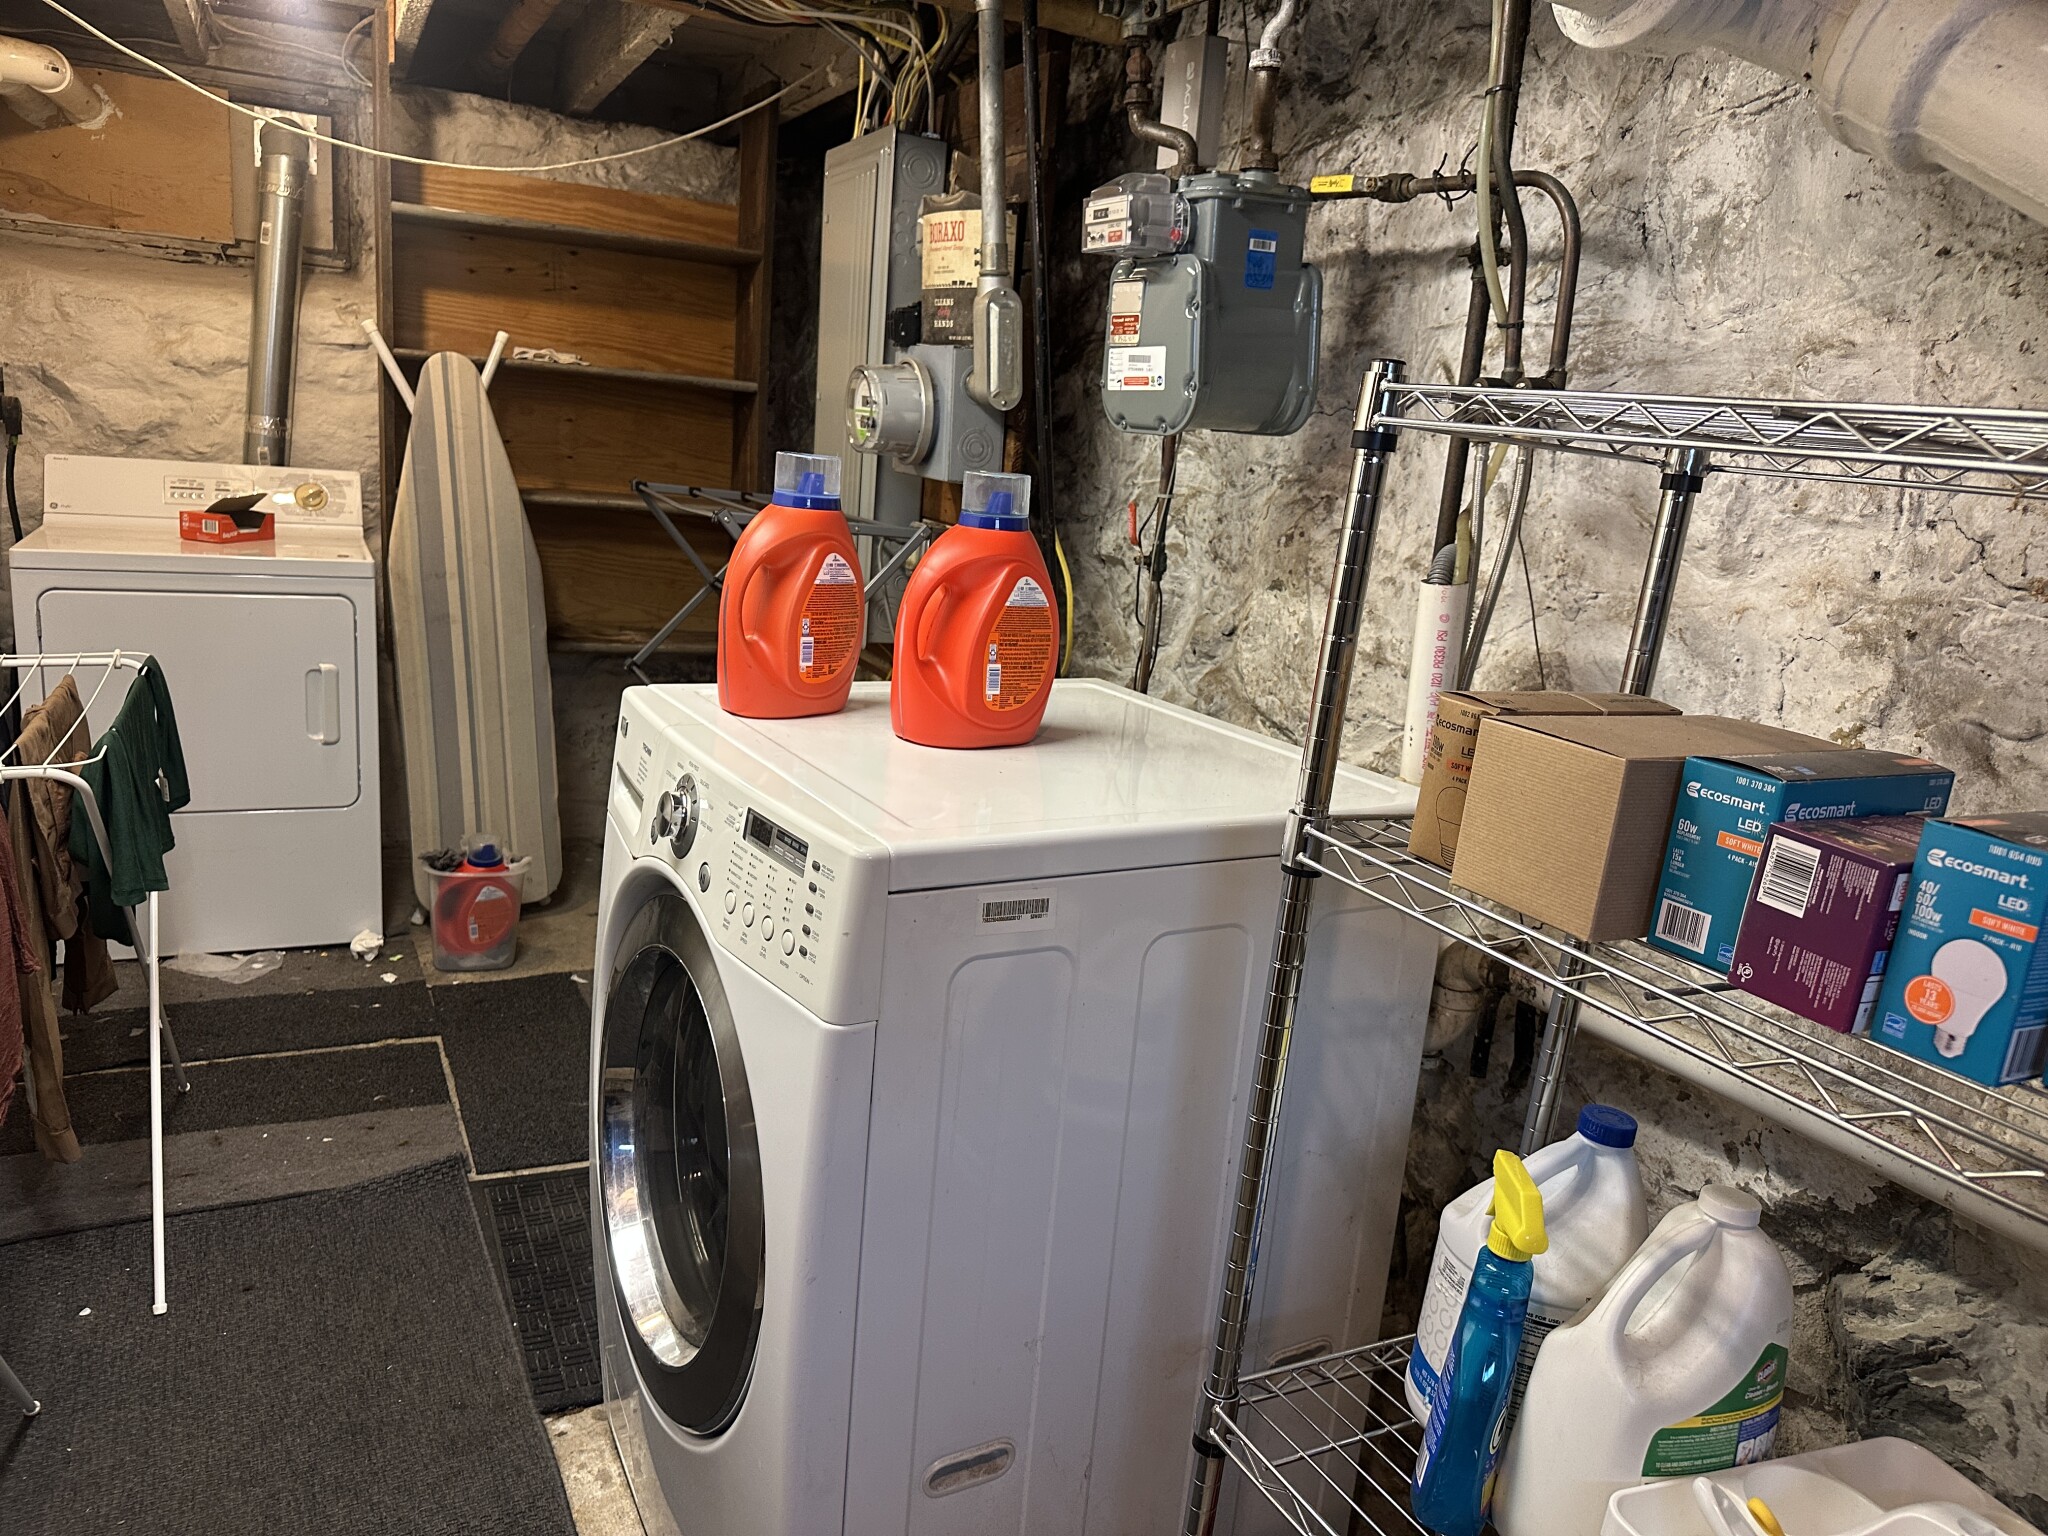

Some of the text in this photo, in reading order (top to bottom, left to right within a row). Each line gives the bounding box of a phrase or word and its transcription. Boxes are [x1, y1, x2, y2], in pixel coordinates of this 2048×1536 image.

[1182, 84, 1191, 131] ACLAR
[930, 221, 965, 244] BORAXO
[934, 298, 954, 306] CLEANS
[1436, 629, 1449, 642] PSI
[1433, 645, 1446, 671] PR330
[1439, 719, 1478, 737] ecosmar
[1461, 746, 1475, 757] LE
[1451, 762, 1464, 771] SOFT
[1736, 776, 1776, 793] 1001 370 384
[1700, 788, 1766, 814] ecosmart
[1924, 796, 1942, 810] LED
[1799, 801, 1856, 819] ecosmart
[1738, 817, 1762, 833] LED
[1725, 837, 1762, 853] SOFT WHITE
[1672, 852, 1682, 862] 15x
[1732, 855, 1745, 864] PACK
[1944, 857, 2029, 889] ecosmart
[1919, 880, 1941, 895] 40/
[1916, 891, 1937, 907] 60/
[1998, 894, 2029, 911] LED
[1907, 928, 1928, 940] INDOOR
[1982, 917, 2025, 936] SOFT WHITE
[1923, 980, 1942, 991] LASTS
[1924, 989, 1937, 1001] 13
